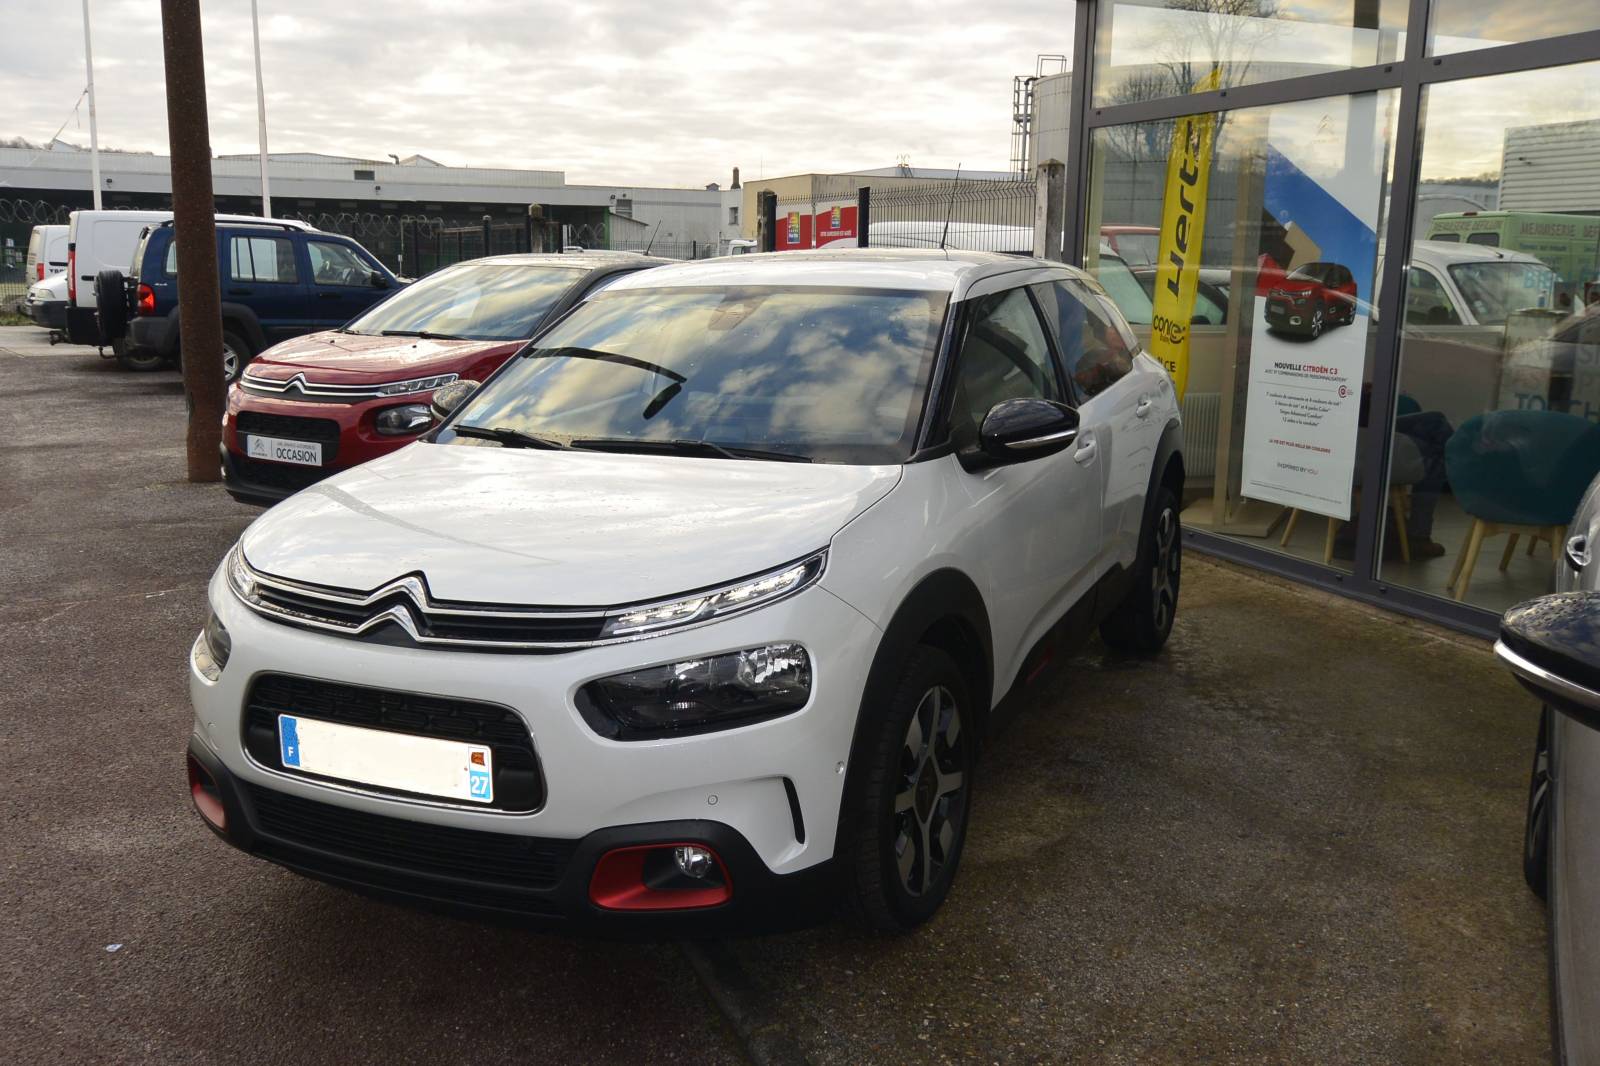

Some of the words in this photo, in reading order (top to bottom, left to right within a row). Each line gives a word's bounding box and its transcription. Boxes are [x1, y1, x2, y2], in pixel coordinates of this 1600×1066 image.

[1274, 361, 1301, 372] NOUVELLE
[1329, 367, 1338, 375] C3
[276, 447, 317, 463] OCCASION
[288, 746, 294, 757] F
[470, 775, 489, 795] 27
